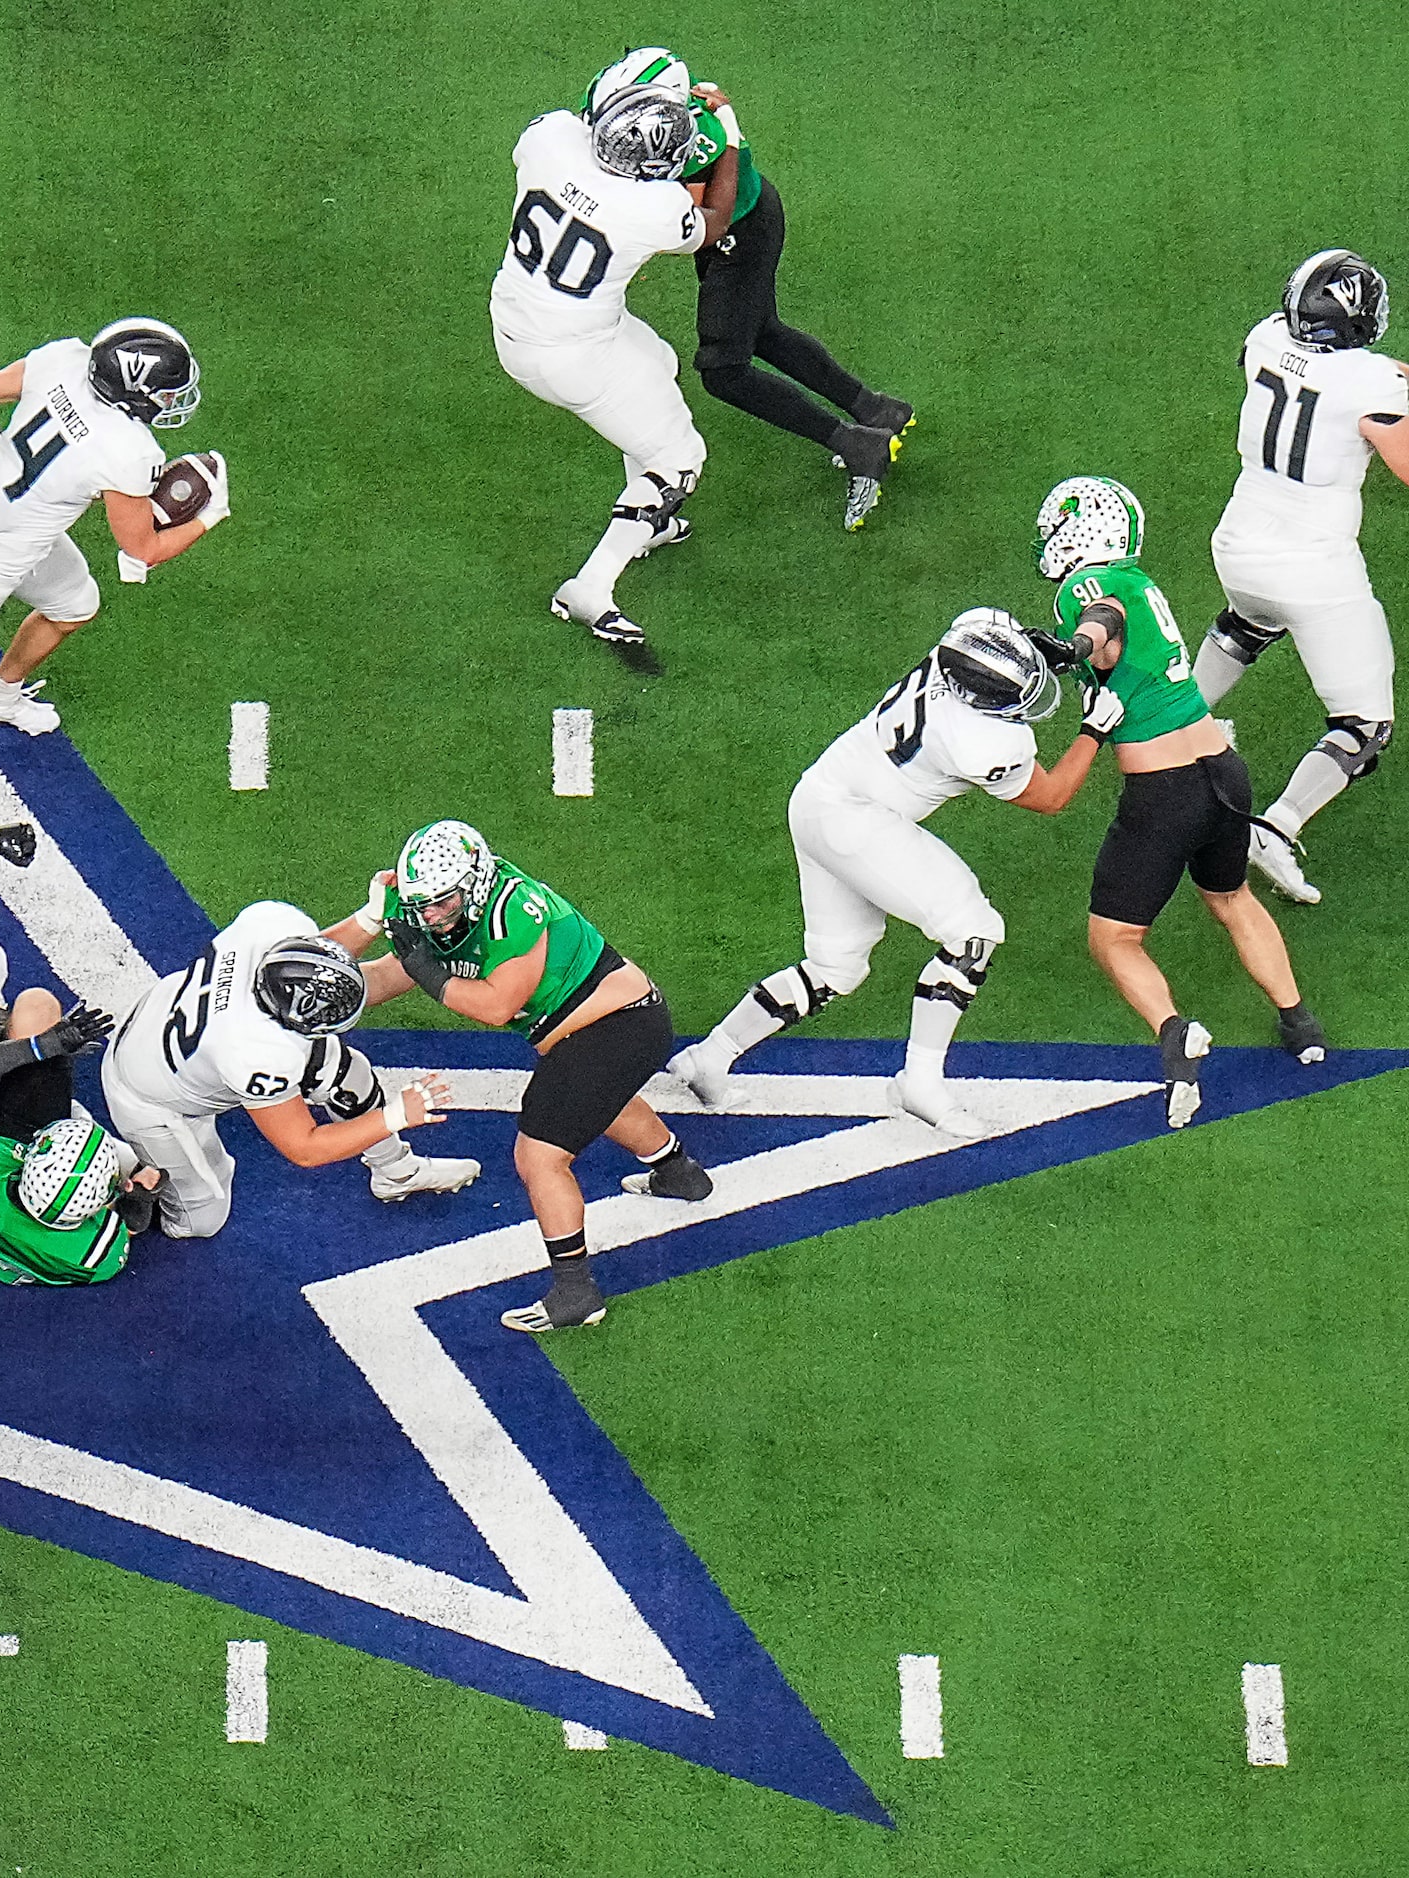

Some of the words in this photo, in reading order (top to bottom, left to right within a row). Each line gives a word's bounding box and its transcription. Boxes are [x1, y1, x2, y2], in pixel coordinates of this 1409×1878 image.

[694, 133, 718, 165] 33
[559, 182, 599, 217] SMITH
[509, 188, 615, 299] 60
[1279, 352, 1309, 378] CECIL
[47, 384, 90, 443] FOURNIER
[1253, 365, 1321, 483] 71
[2, 405, 70, 503] 4
[1071, 576, 1104, 607] 90
[213, 950, 237, 1016] SPRINGER
[245, 1071, 290, 1097] 62
